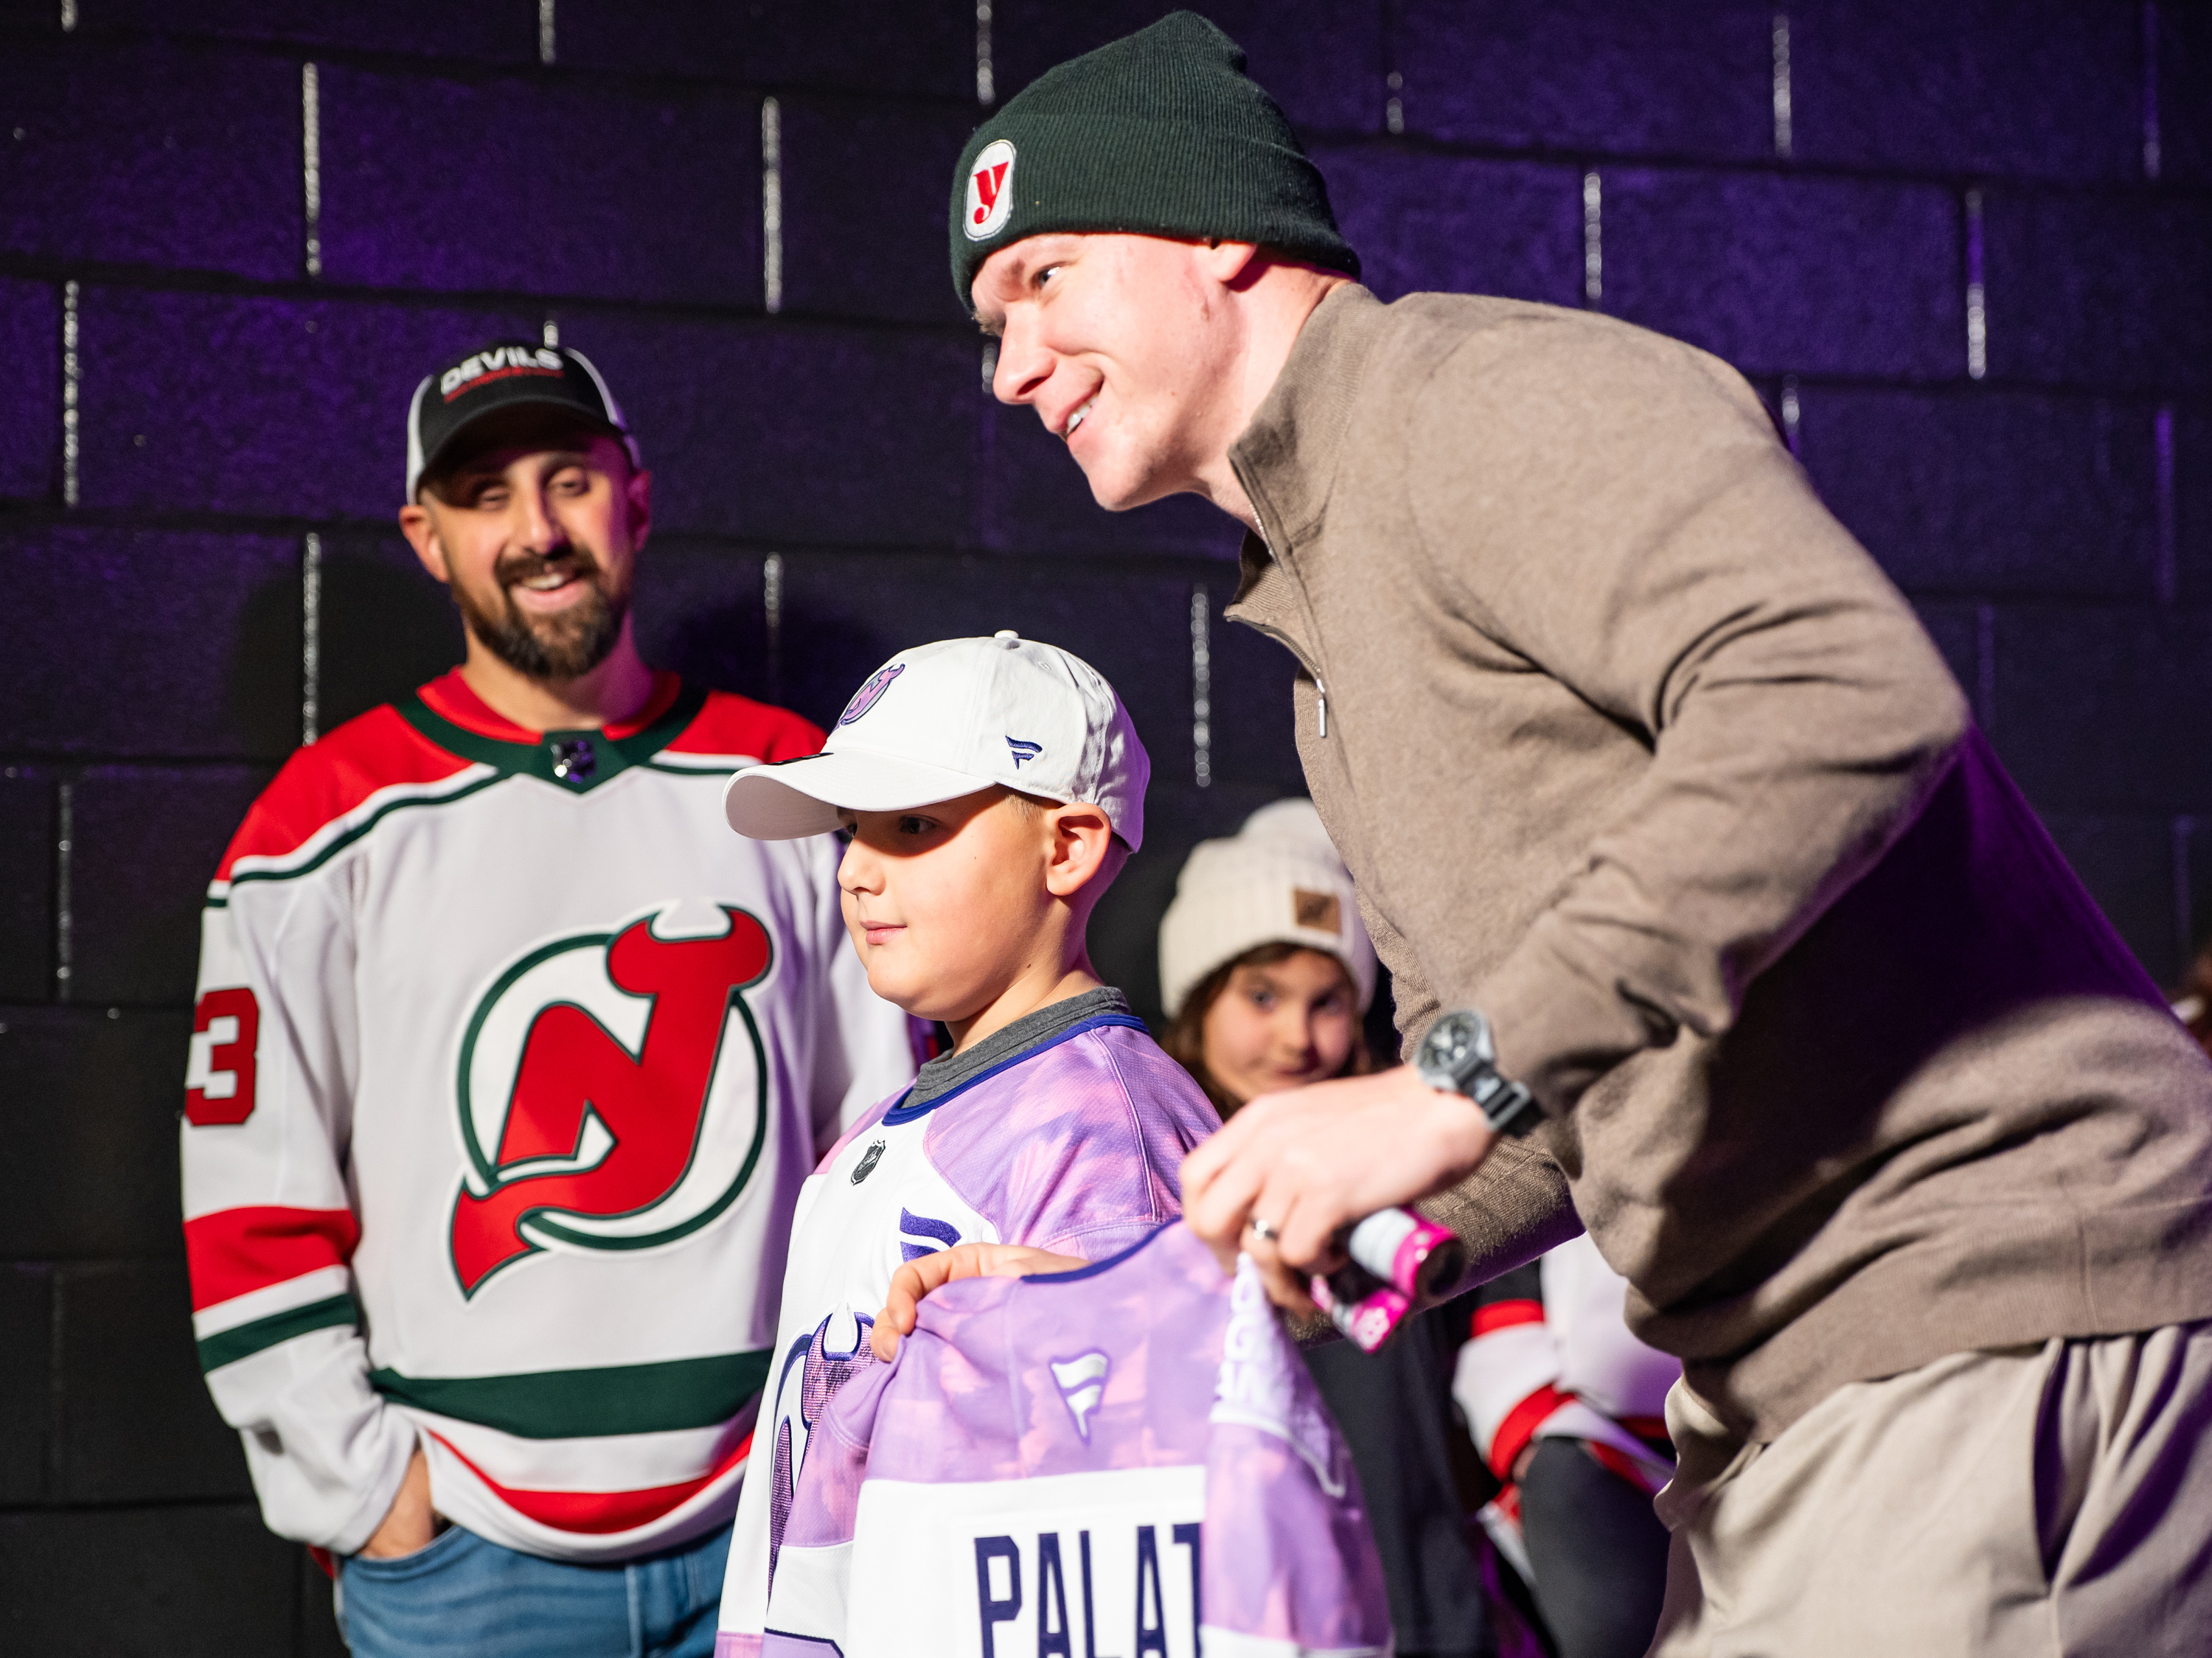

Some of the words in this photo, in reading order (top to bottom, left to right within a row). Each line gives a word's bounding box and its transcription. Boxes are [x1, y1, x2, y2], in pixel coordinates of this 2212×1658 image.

[973, 161, 1009, 224] y
[440, 346, 564, 395] DEVILS
[184, 988, 259, 1126] 3
